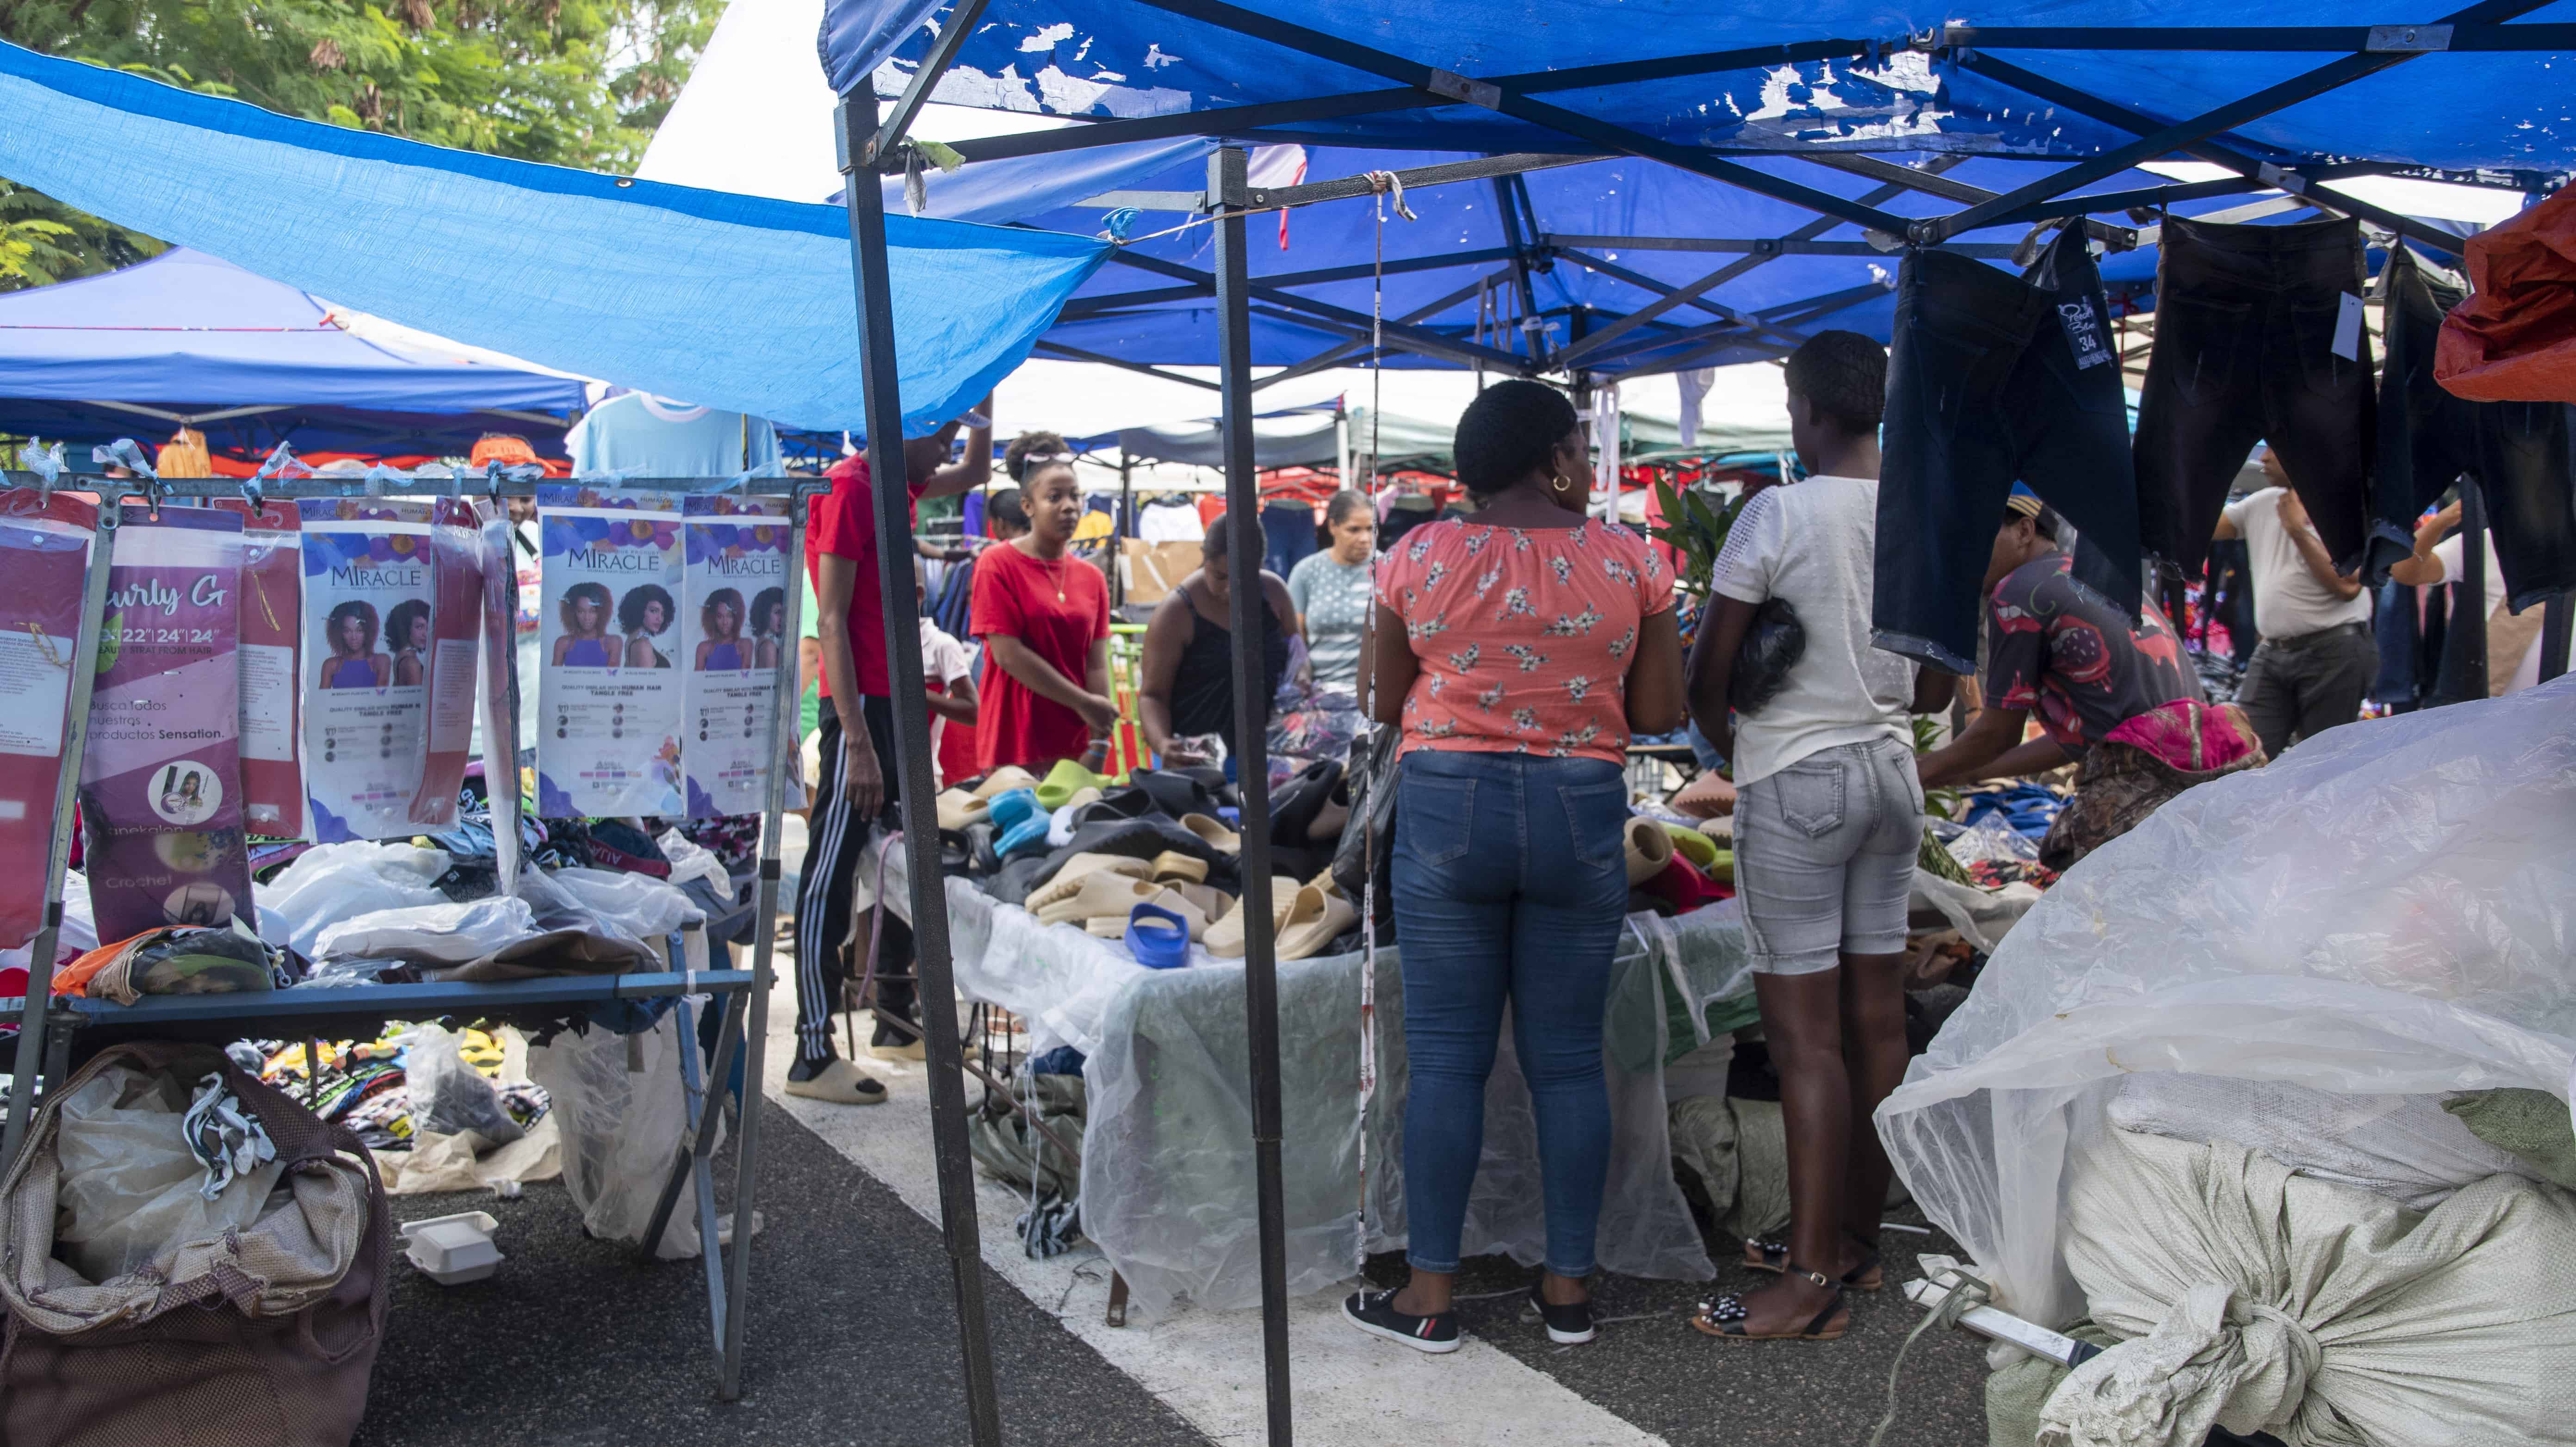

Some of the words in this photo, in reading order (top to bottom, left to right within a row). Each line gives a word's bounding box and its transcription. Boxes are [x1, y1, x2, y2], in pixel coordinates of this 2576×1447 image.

[2079, 334, 2096, 352] 34
[568, 548, 659, 571] MIRACLE
[708, 555, 780, 574] MIRACLE
[332, 566, 421, 586] MIRACLE
[105, 578, 182, 616] urly
[88, 729, 155, 741] productos
[158, 728, 225, 740] Sensation.
